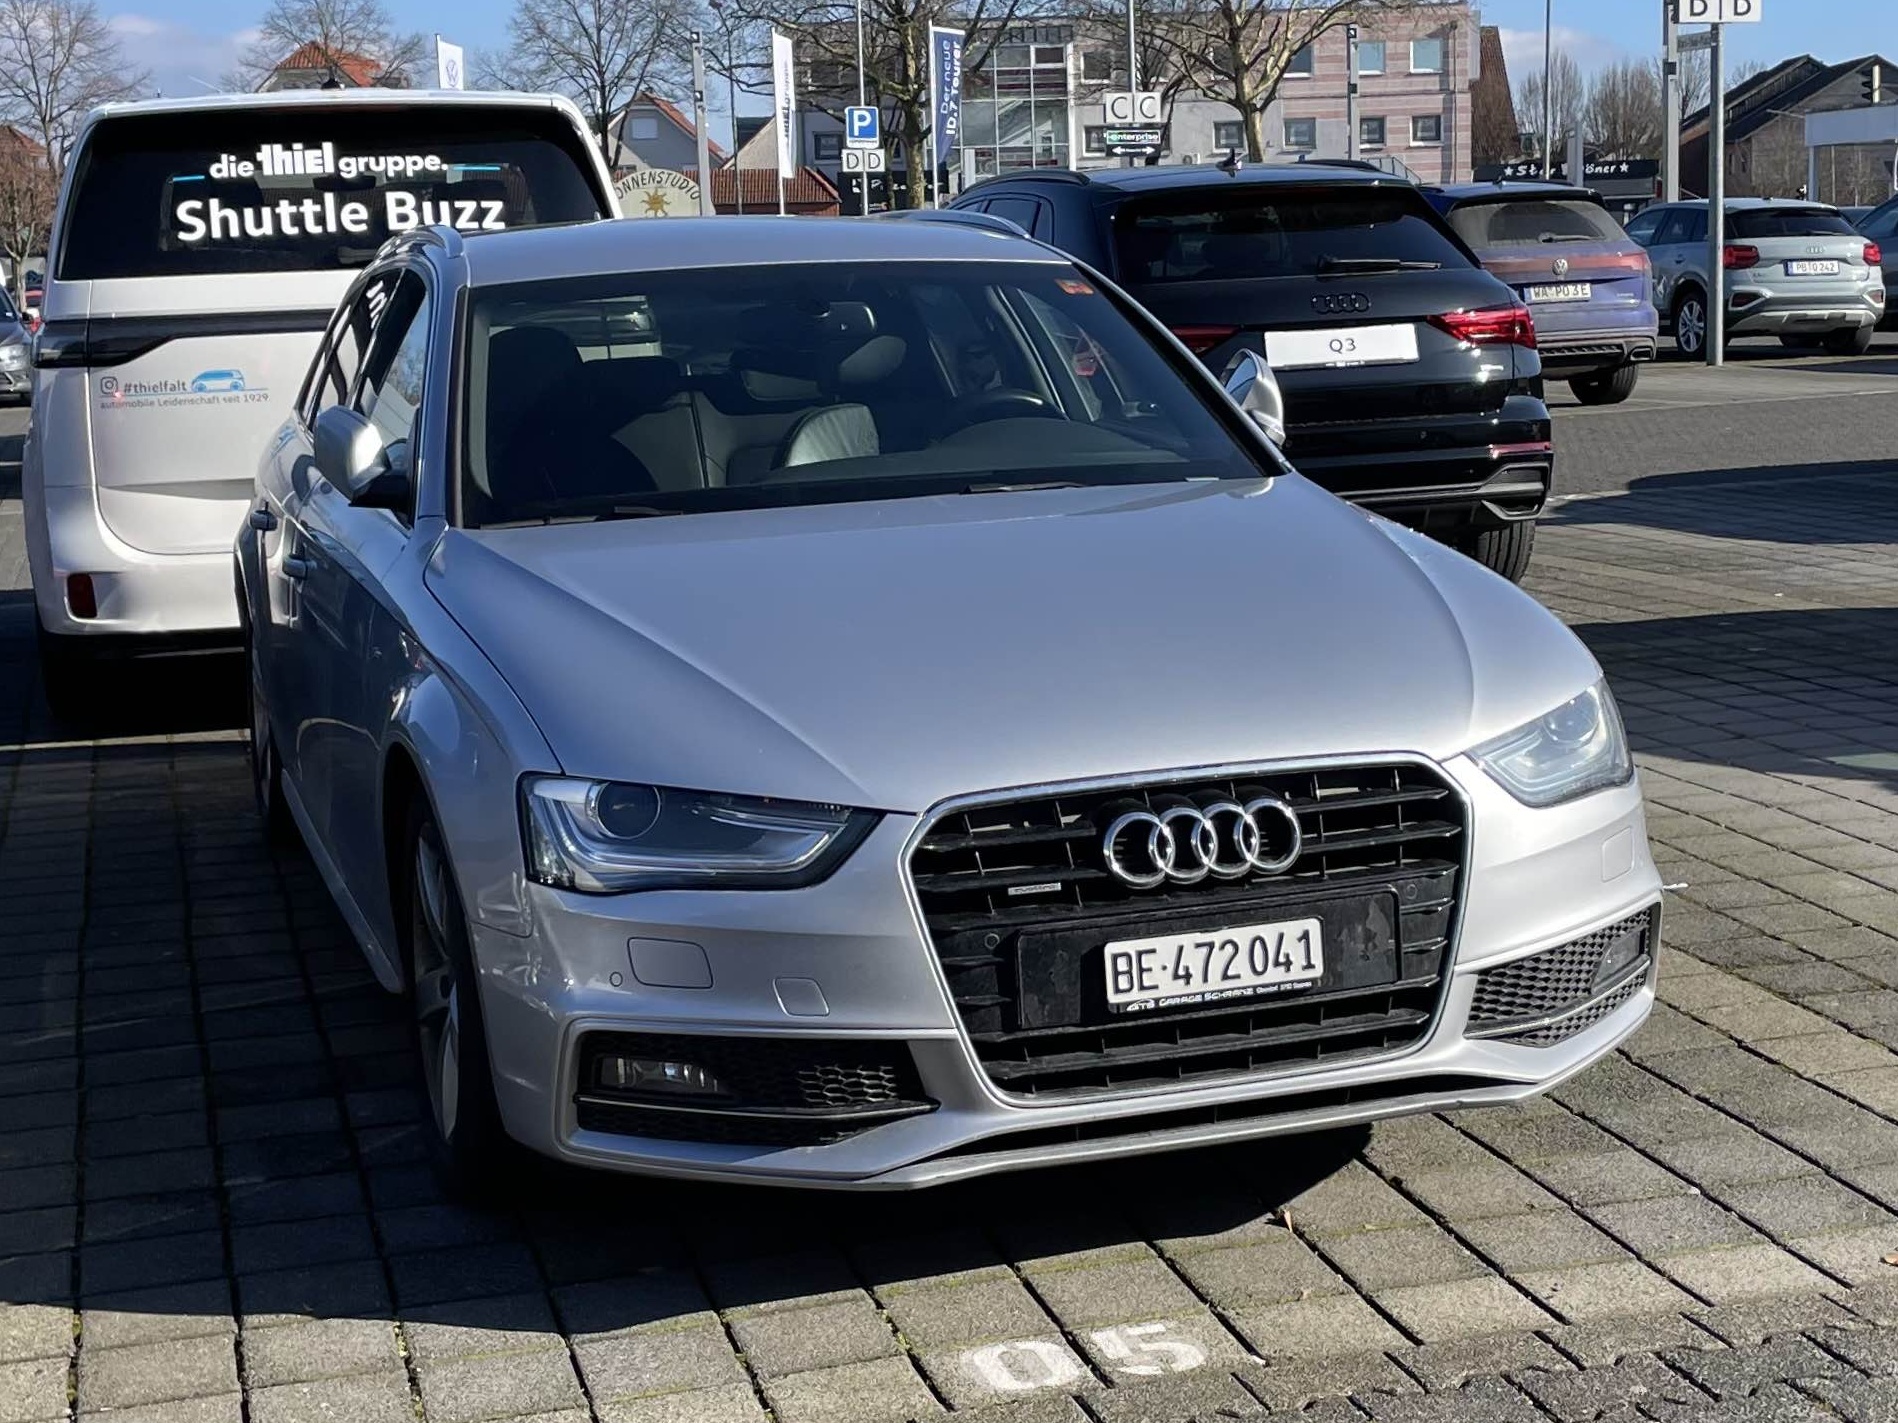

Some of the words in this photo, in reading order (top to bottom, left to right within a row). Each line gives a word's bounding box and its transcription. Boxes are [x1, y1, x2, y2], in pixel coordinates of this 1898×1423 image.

[943, 40, 951, 80] neue
[951, 41, 961, 96] Tourer
[941, 86, 950, 114] Der
[1111, 96, 1128, 119] C
[1140, 96, 1156, 119] C
[853, 110, 872, 136] P
[945, 100, 958, 135] ID.7
[209, 154, 254, 179] die
[338, 154, 449, 178] gruppe.
[847, 153, 859, 169] D
[868, 153, 881, 169] D
[1583, 162, 1617, 174] öner
[615, 170, 700, 200] ONNENSTUDIO
[176, 192, 369, 241] Shuttle
[385, 190, 505, 231] Buzz
[124, 380, 187, 393] #thielfalt
[158, 395, 220, 407] Leidenschaft
[223, 395, 241, 404] seit
[244, 393, 269, 402] 1929
